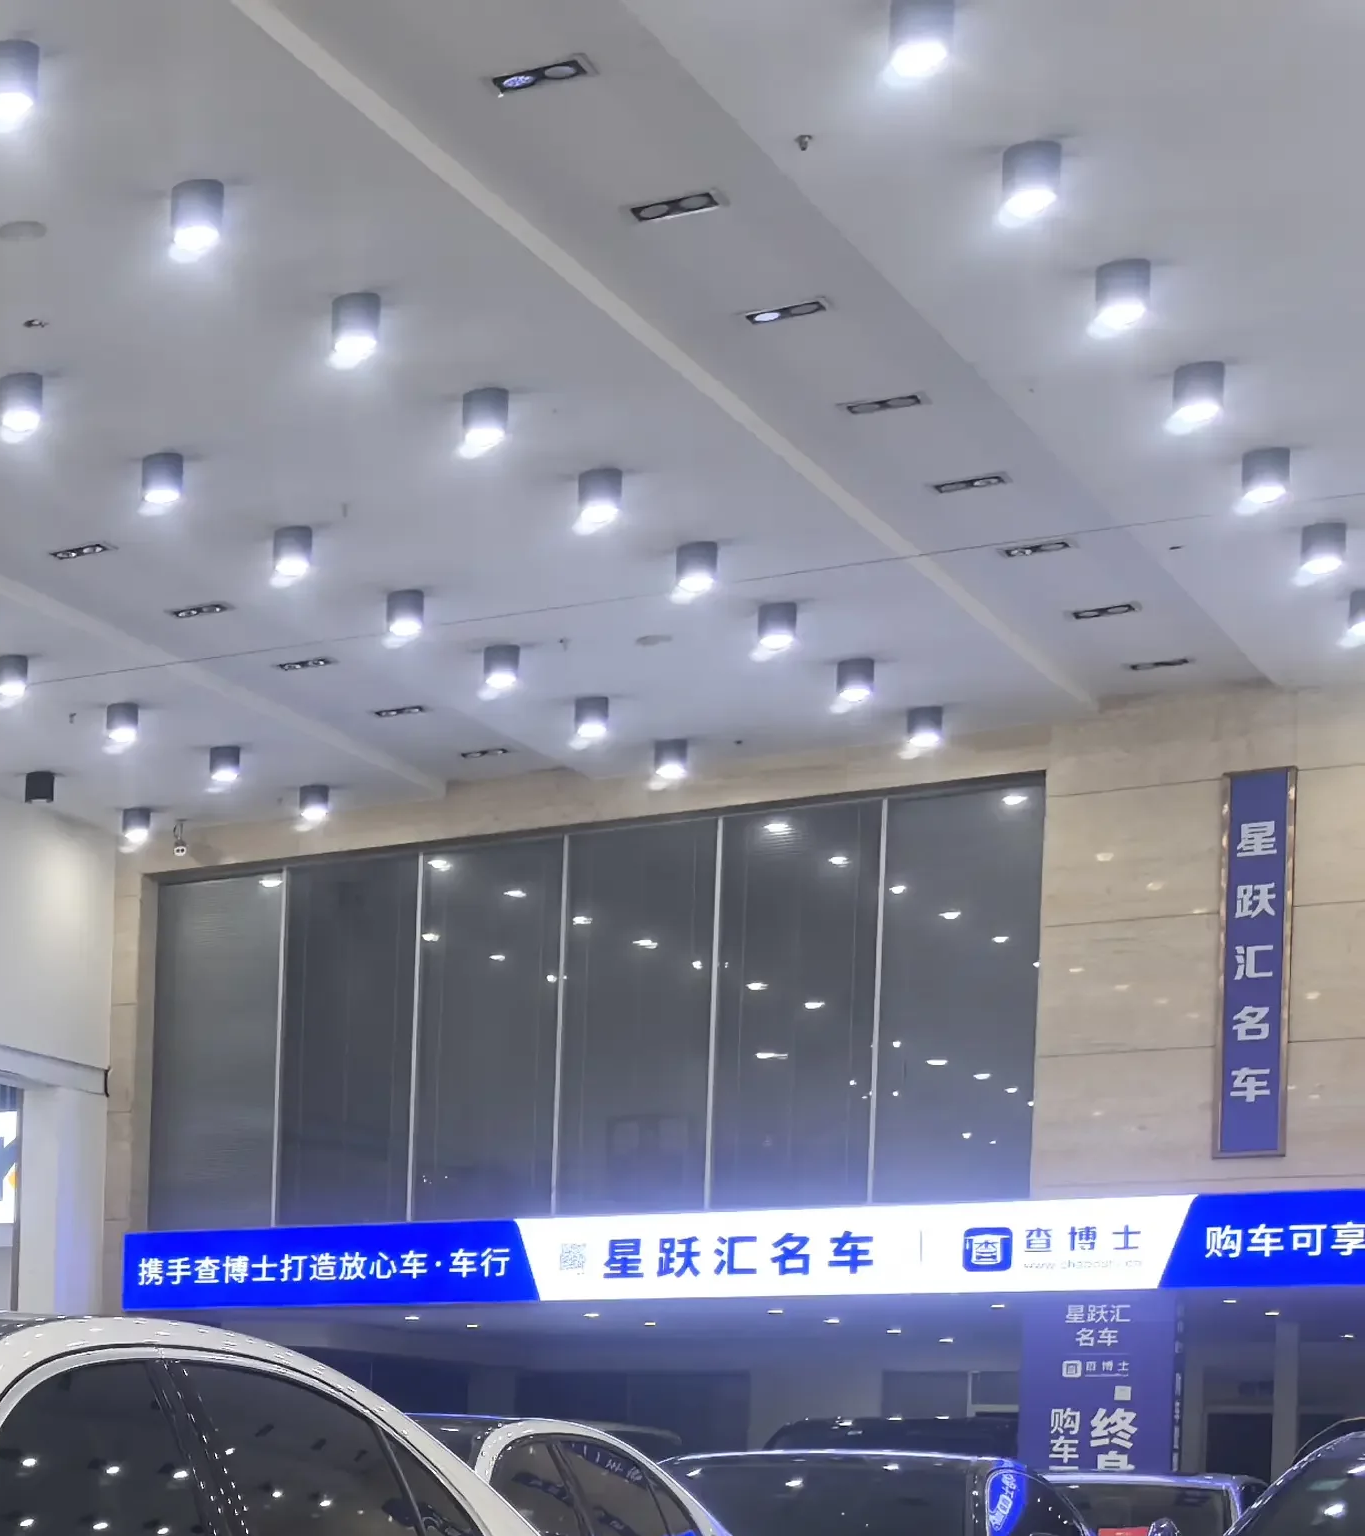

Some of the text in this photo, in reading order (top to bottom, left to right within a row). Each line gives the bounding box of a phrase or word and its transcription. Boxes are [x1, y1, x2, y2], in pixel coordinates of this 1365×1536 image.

[1230, 820, 1278, 1103] 星跃汇名车
[602, 1230, 874, 1279] 星跃汇名车
[1024, 1224, 1141, 1253] 查博士
[1204, 1221, 1365, 1259] 购车可享
[137, 1247, 511, 1286] 携手查博士打造放心车·车行
[1065, 1304, 1131, 1324] 星跃汇
[1075, 1327, 1119, 1347] 名车
[1049, 1408, 1080, 1471] 购车
